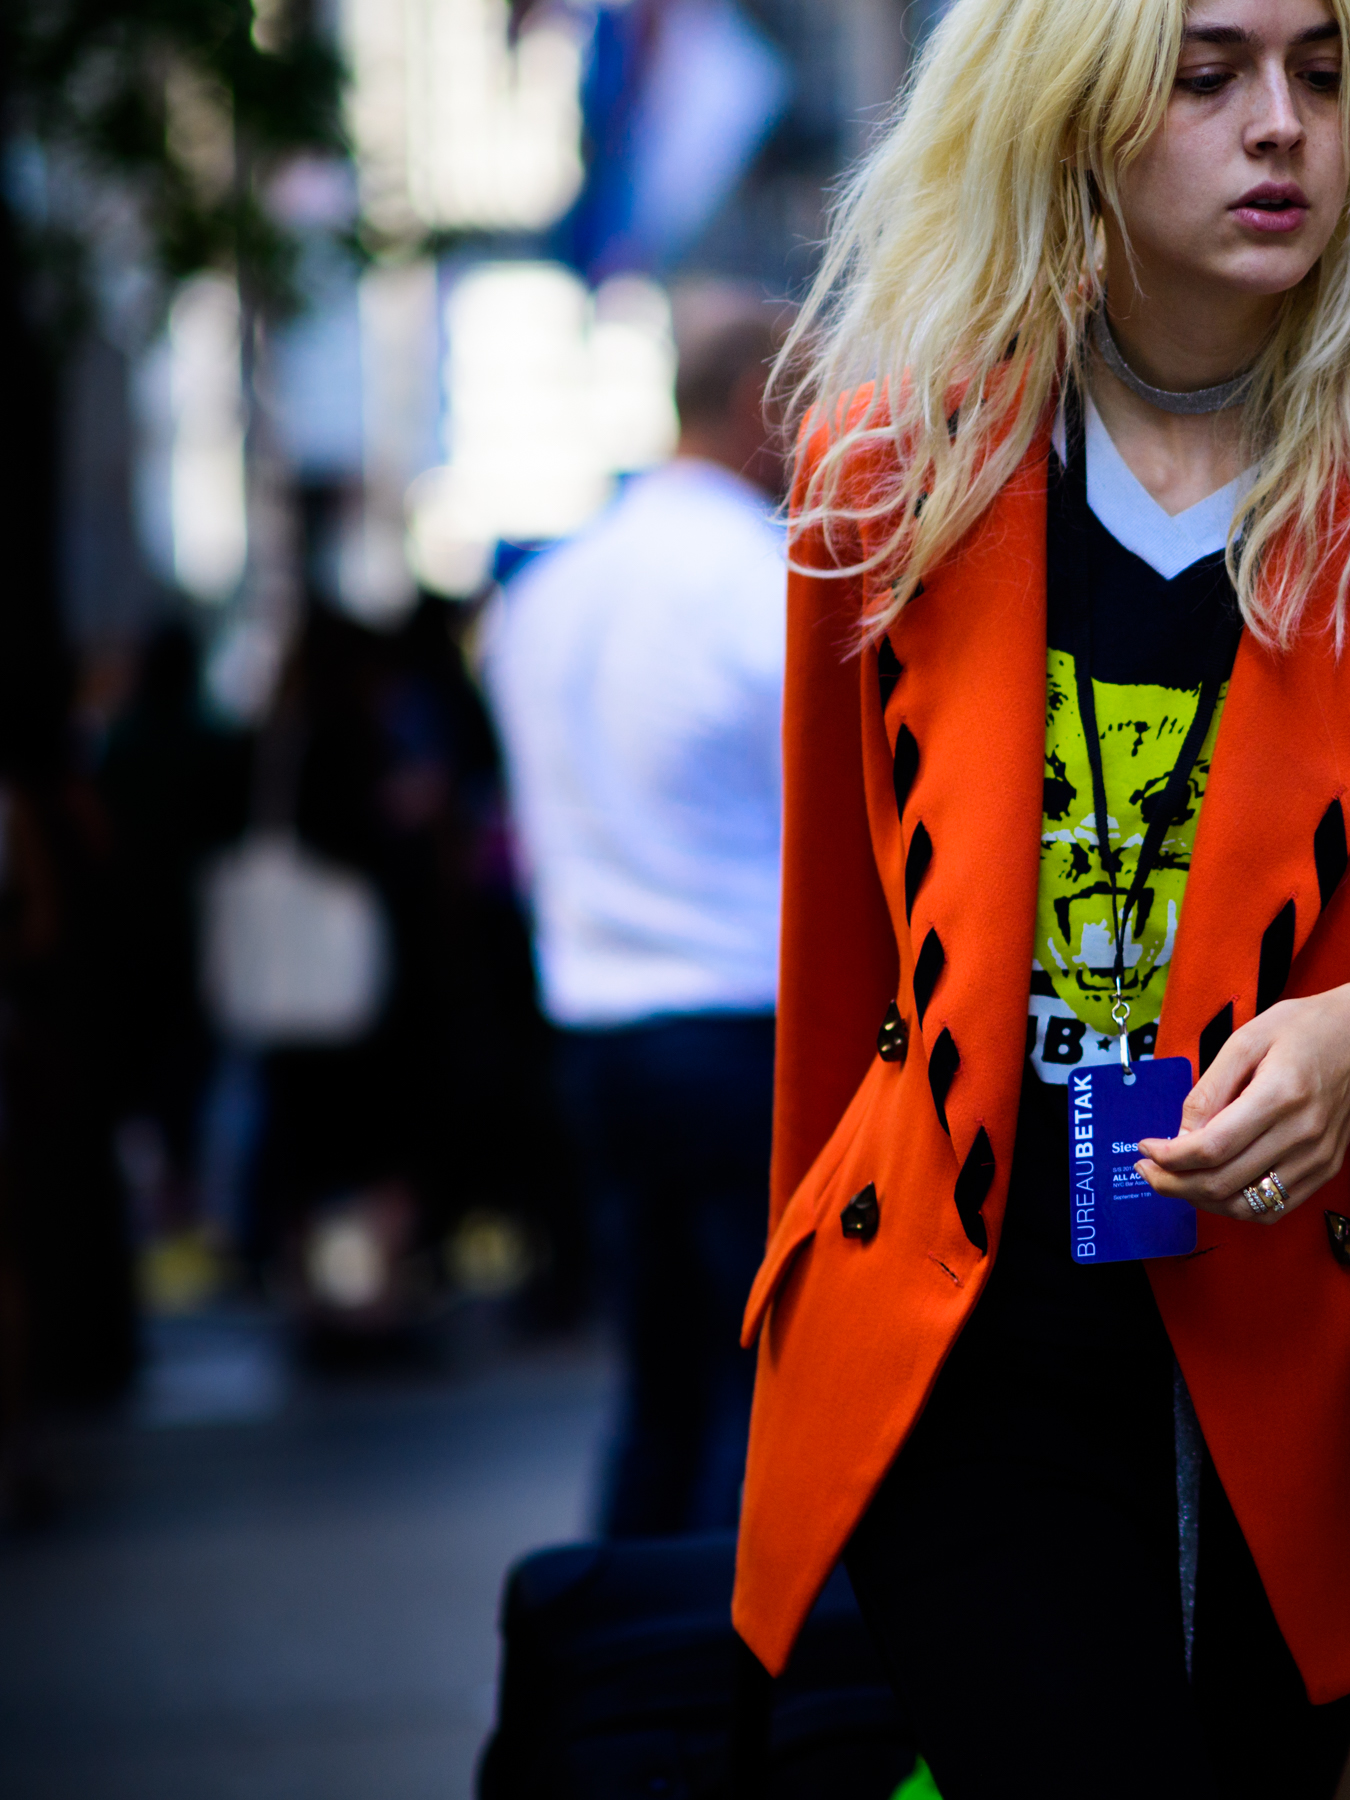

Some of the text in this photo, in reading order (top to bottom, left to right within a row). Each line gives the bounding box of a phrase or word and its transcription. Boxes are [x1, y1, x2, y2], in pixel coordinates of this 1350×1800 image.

[1073, 1073, 1096, 1257] BUREAUBETAK
[1112, 1172, 1142, 1182] ALL AC
